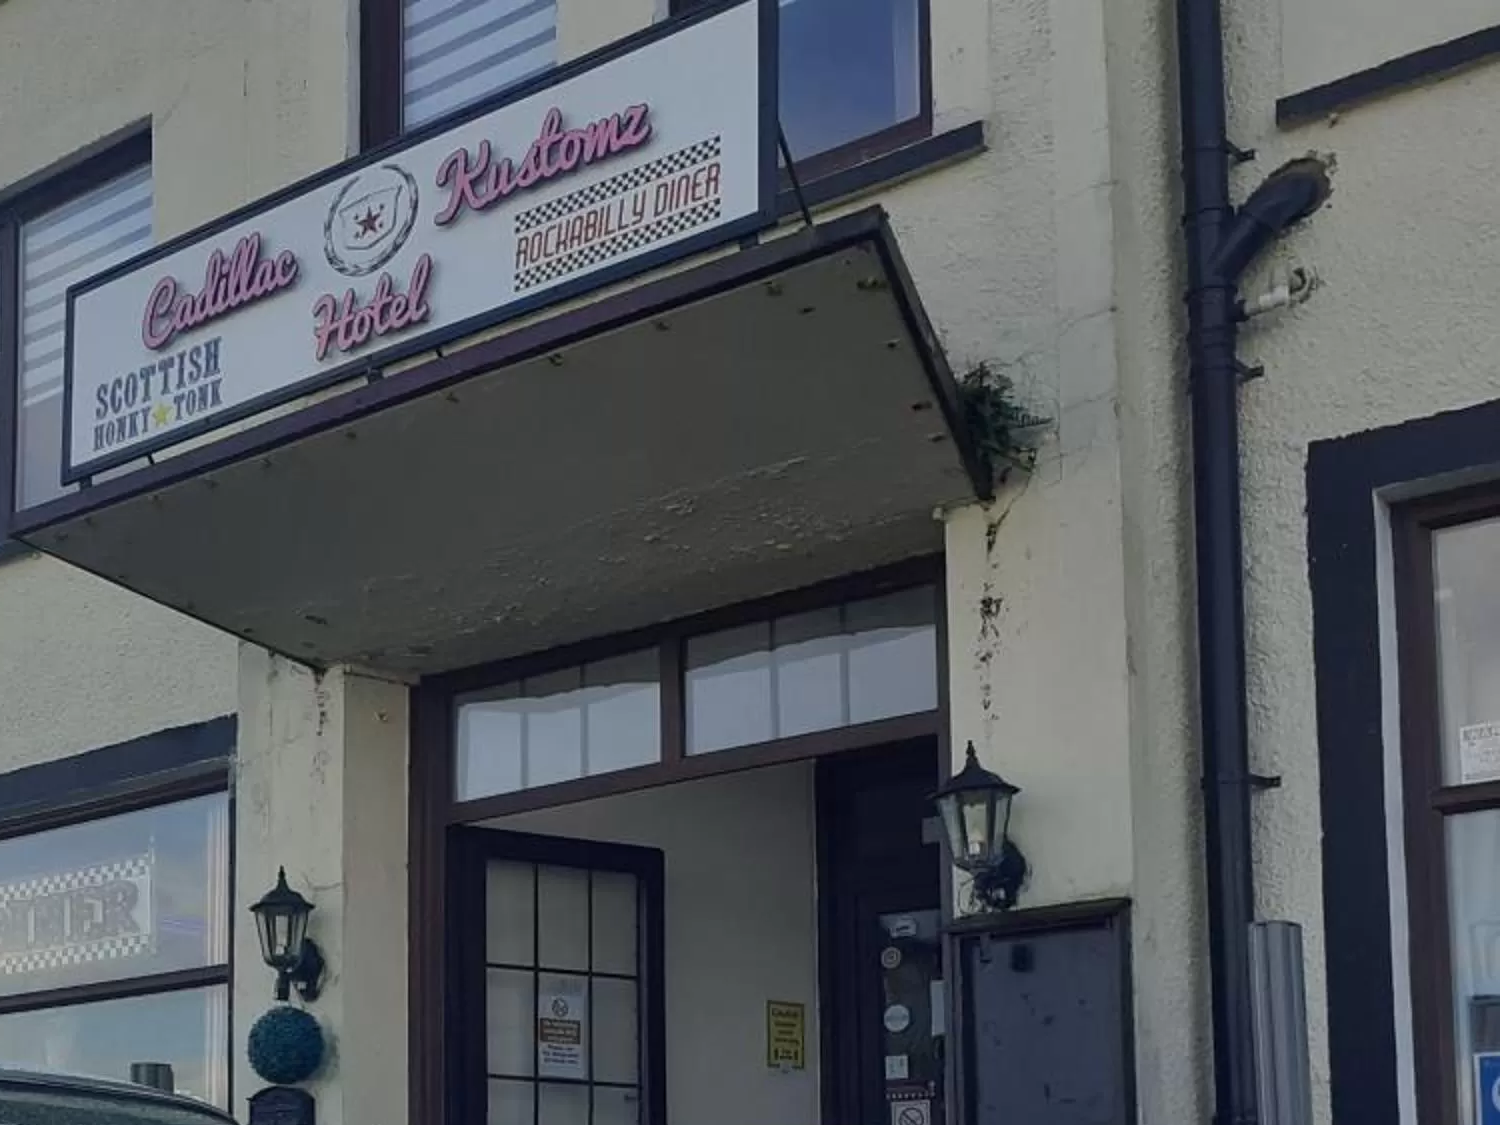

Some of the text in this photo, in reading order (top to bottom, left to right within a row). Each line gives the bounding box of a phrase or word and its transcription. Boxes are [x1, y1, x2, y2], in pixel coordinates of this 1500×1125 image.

[434, 102, 653, 226] Kustomz
[515, 161, 720, 269] ROCKABILLY DINER
[141, 230, 299, 350] Cadillac
[311, 252, 433, 361] Hotel
[92, 377, 223, 452] HONKY TONK
[95, 336, 222, 420] SCOTTISH
